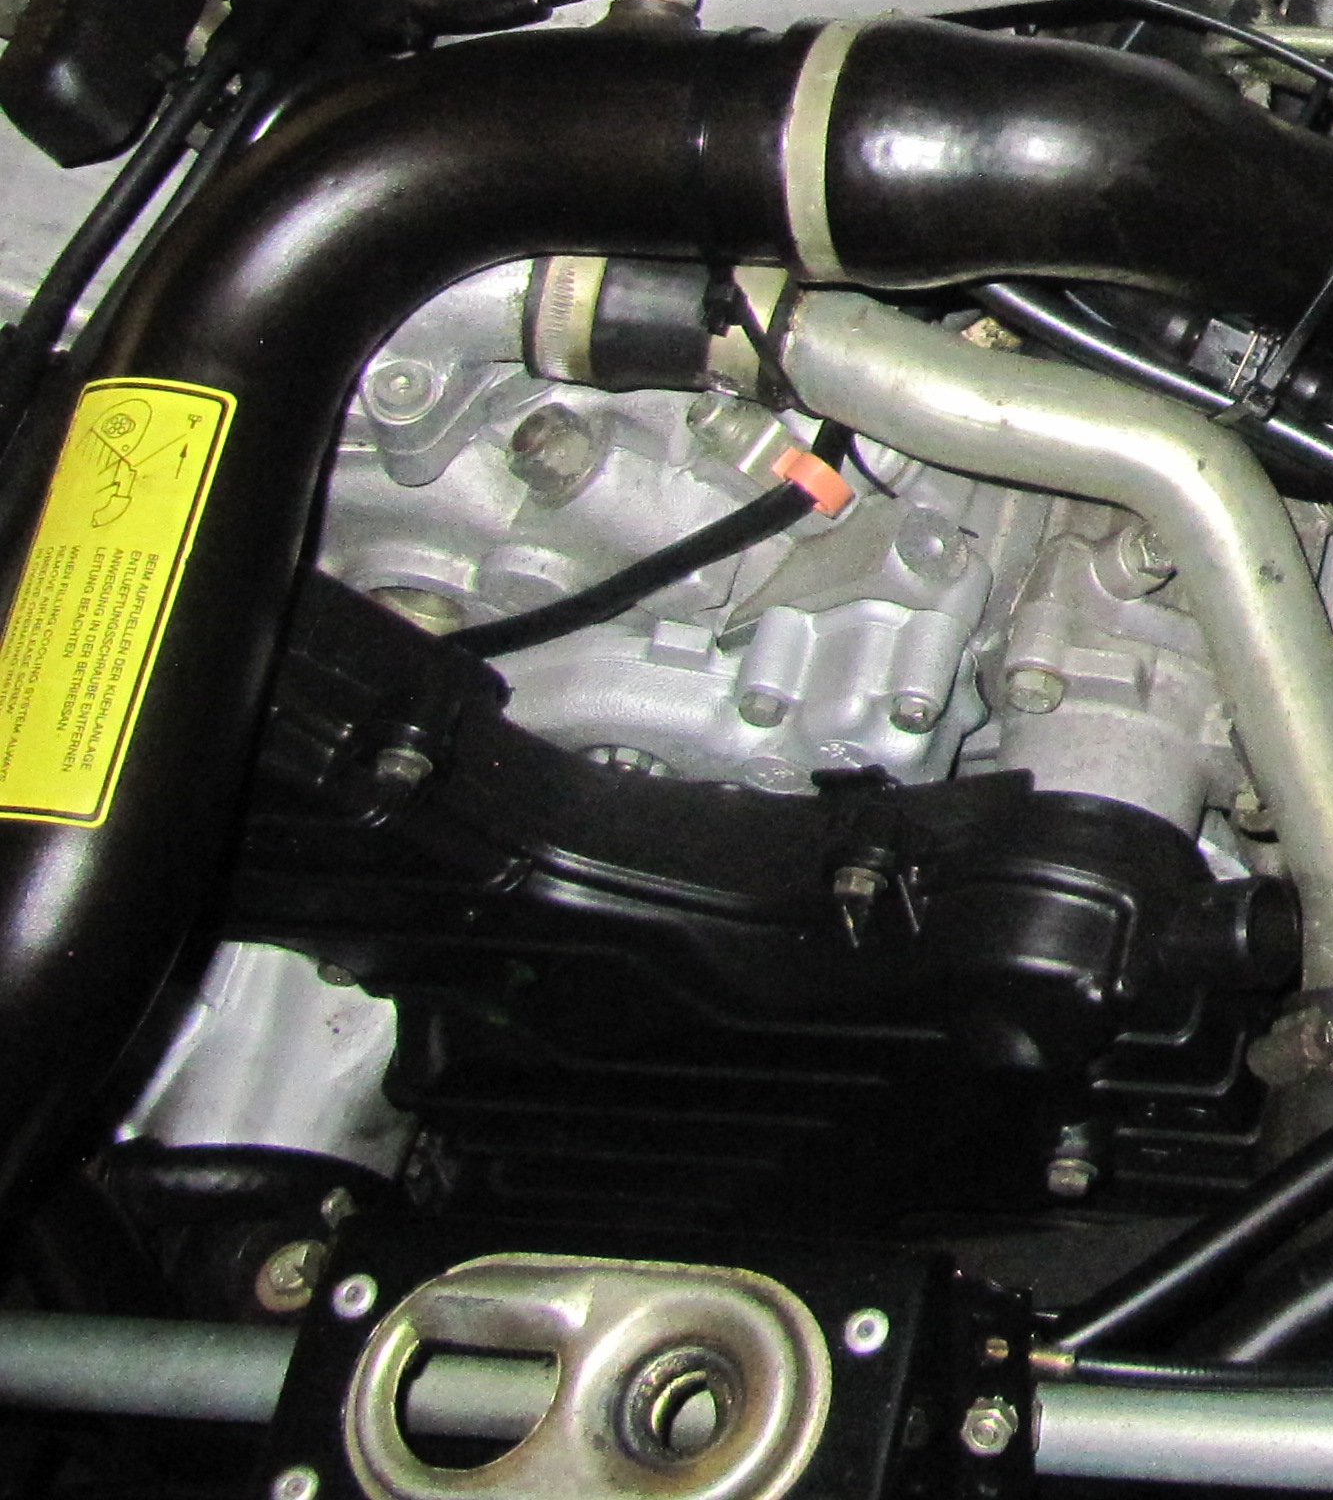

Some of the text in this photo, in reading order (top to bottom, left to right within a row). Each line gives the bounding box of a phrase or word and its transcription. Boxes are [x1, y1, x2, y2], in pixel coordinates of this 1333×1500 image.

[61, 545, 80, 579] WHEN
[93, 547, 124, 616] ANWEISUNG
[46, 582, 68, 625] FILLING
[62, 546, 107, 658] LEITUNG BEACHTEN
[88, 619, 101, 631] IN
[27, 628, 54, 683] COOLING
[60, 550, 142, 772] ENTLUEFTUNGSSCHRAUBE ENTFERNEN
[79, 634, 96, 657] DER
[79, 553, 159, 771] BEIM AUFFUELLEN DER KUEHLANLAGE
[11, 686, 35, 734] SYSTEM
